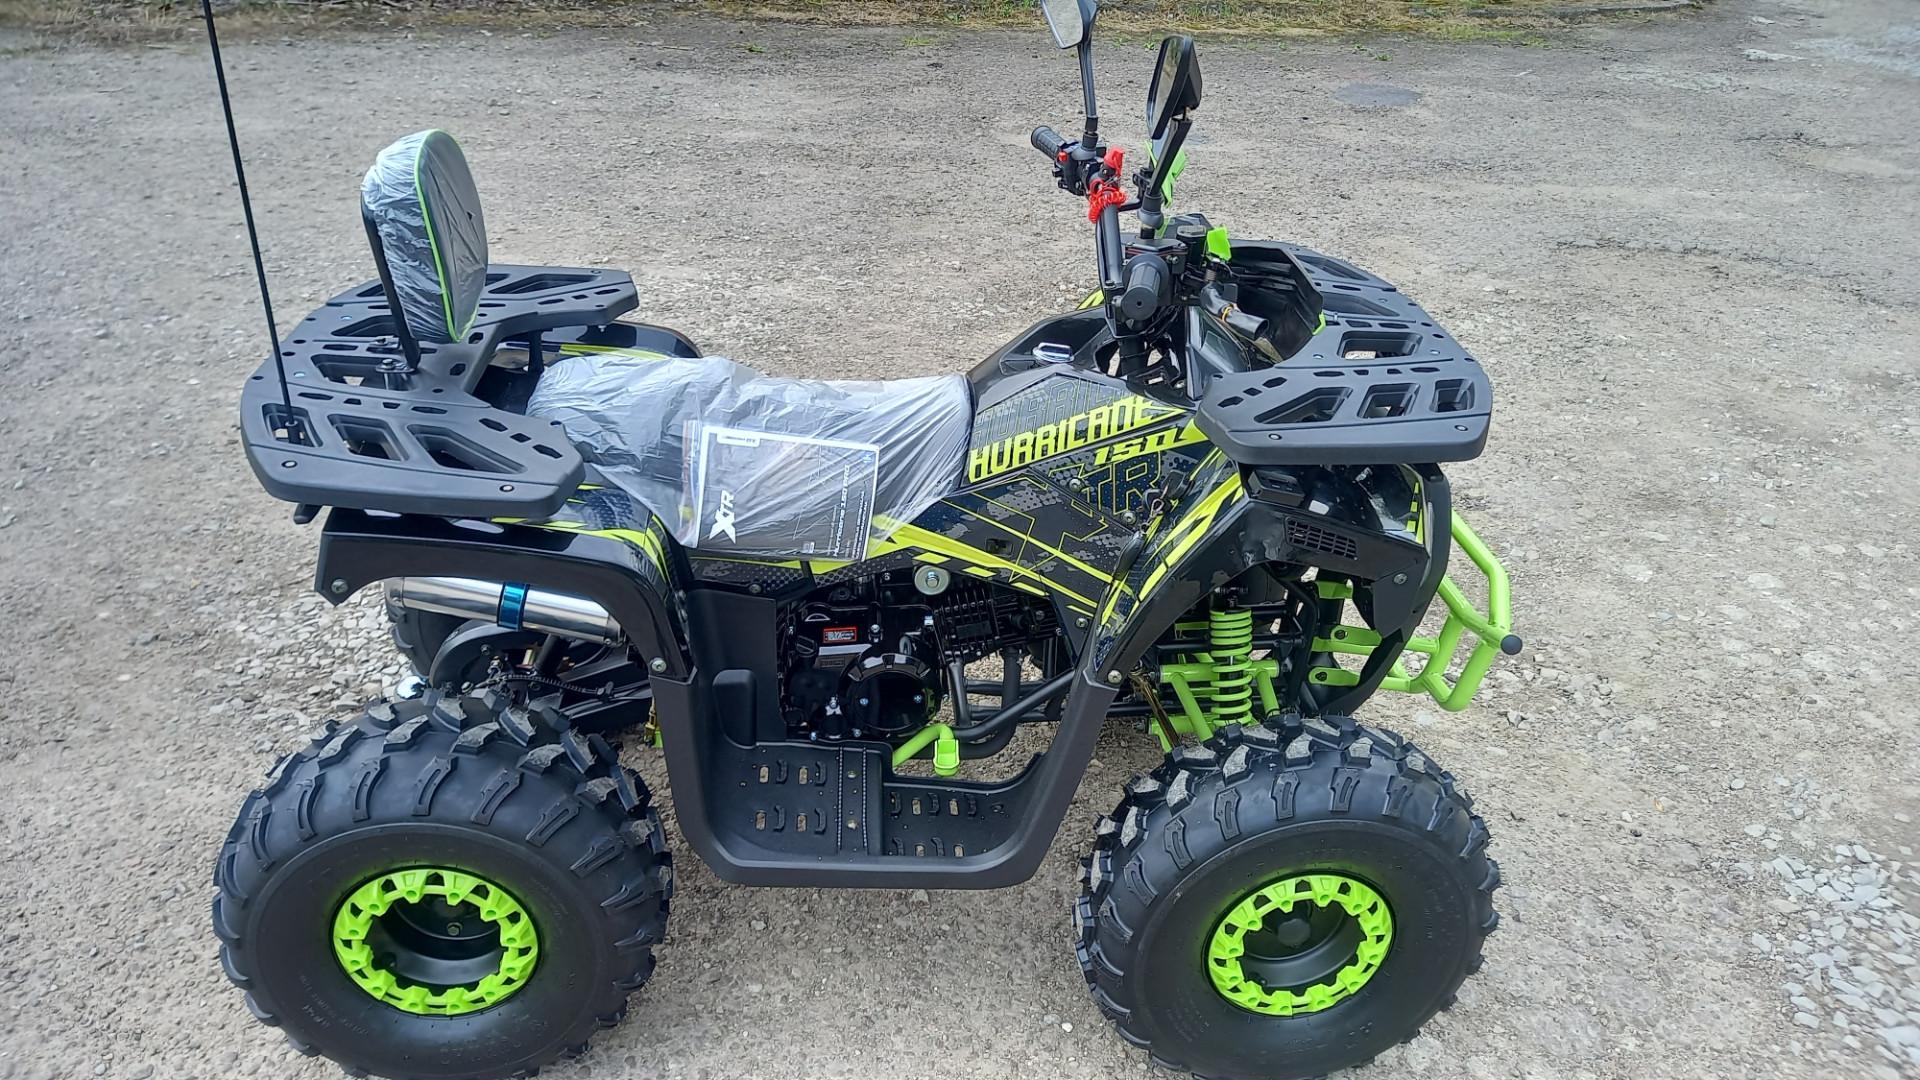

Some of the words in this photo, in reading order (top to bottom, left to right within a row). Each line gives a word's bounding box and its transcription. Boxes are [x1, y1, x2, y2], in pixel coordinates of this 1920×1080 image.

[969, 395, 1187, 483] HURRICANE
[1093, 426, 1179, 466] 150
[708, 489, 736, 544] XTR
